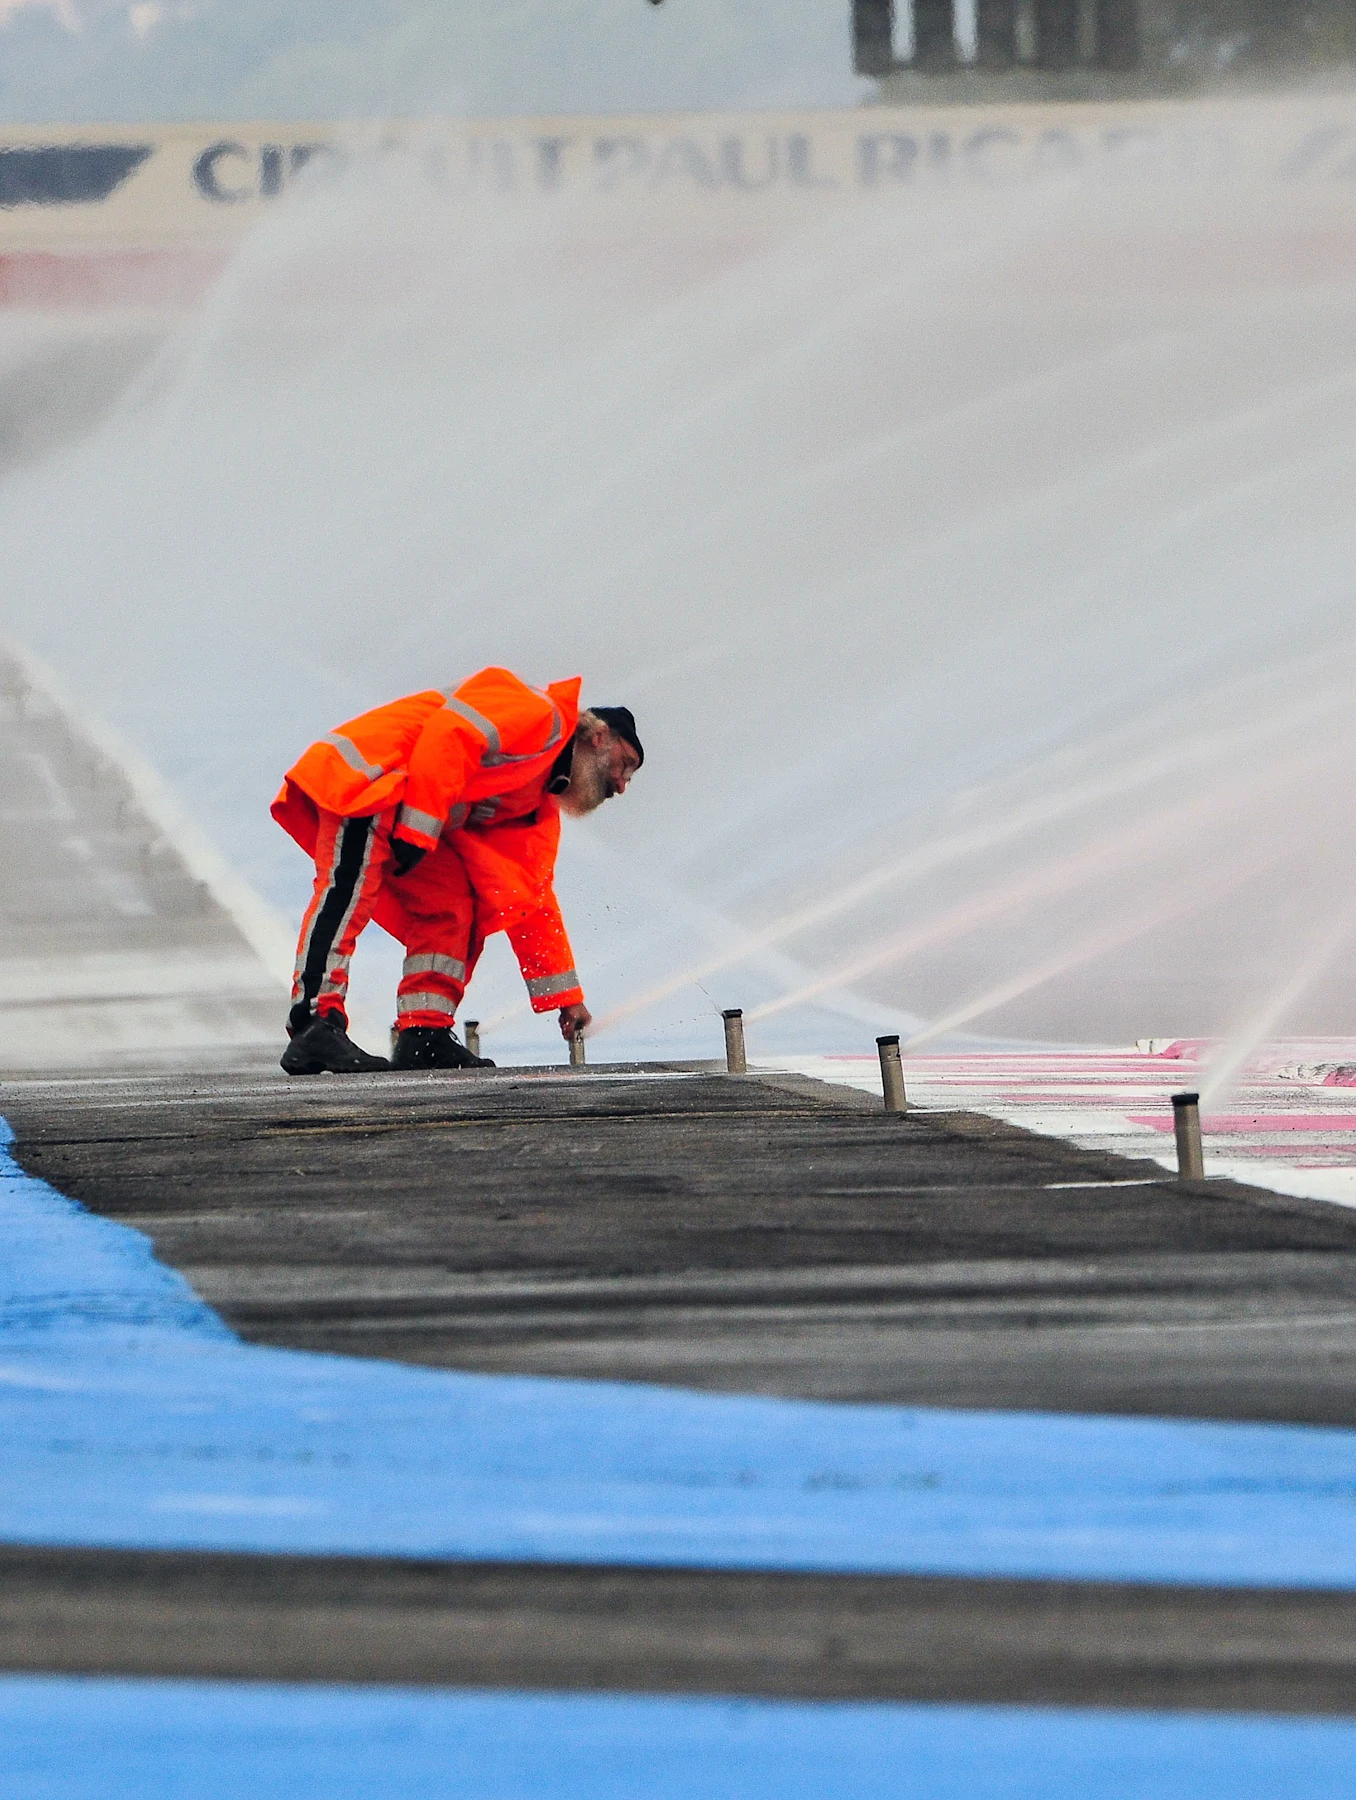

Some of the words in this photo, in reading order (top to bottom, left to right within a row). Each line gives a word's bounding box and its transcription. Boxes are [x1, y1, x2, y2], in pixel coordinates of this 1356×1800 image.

[191, 136, 573, 204] CIRUIT
[592, 131, 841, 192] PAUL
[857, 123, 1243, 192] RICA
